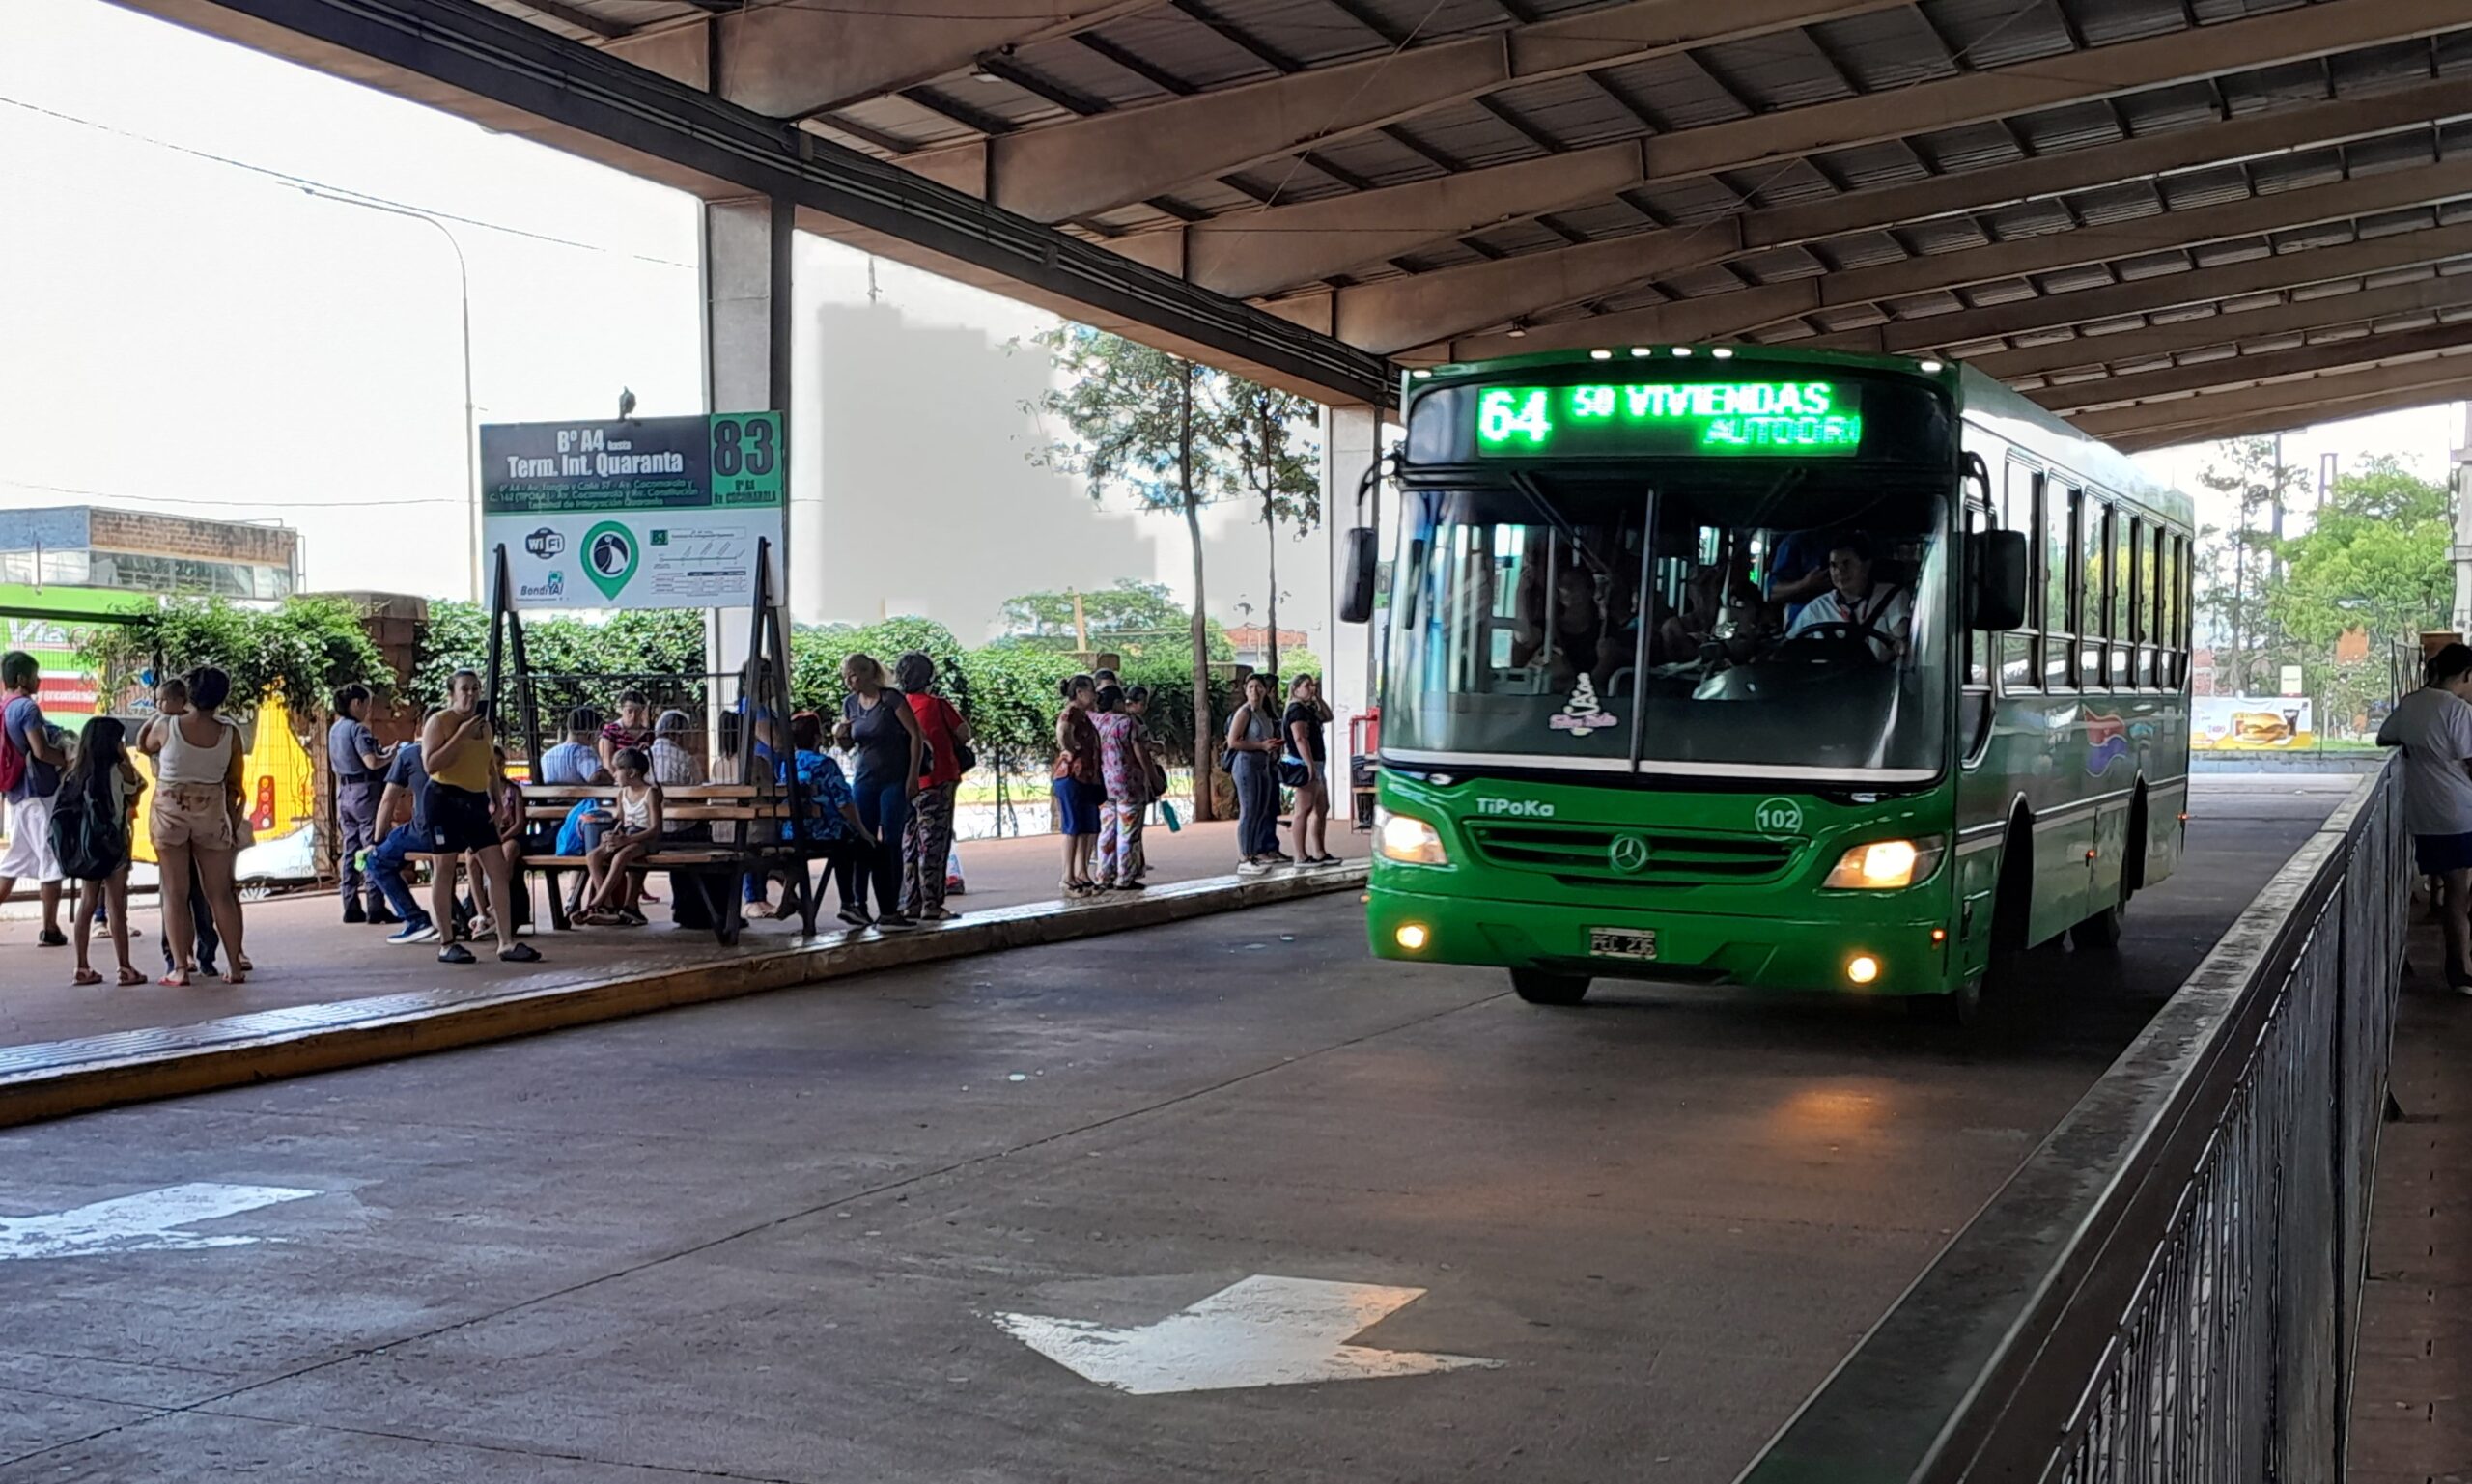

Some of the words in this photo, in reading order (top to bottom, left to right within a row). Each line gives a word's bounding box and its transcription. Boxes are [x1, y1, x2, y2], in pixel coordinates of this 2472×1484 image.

[1624, 382, 1832, 417] VIVIENDAS
[1478, 389, 1553, 442] 64
[580, 428, 605, 453] A4
[713, 418, 774, 477] 83
[506, 455, 560, 479] Term.
[595, 451, 684, 478] Quaranta
[1758, 809, 1799, 828] 102
